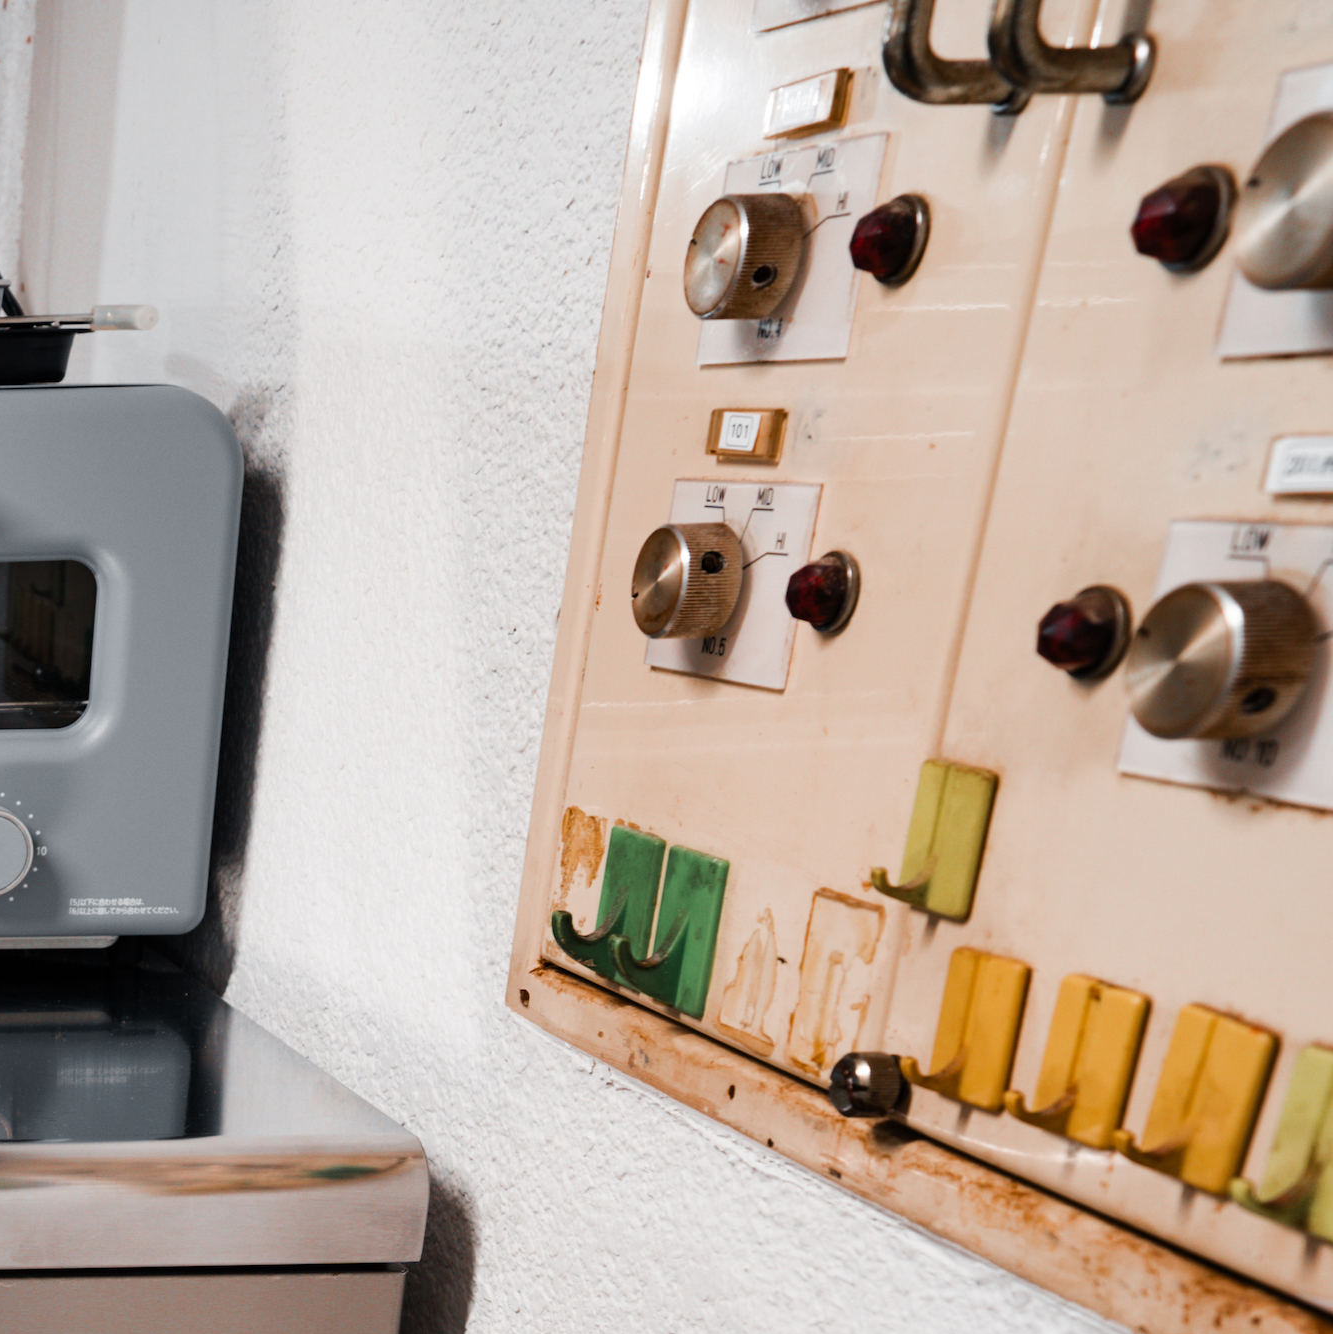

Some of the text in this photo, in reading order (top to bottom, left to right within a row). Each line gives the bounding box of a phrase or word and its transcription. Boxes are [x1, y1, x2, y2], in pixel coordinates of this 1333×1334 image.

[815, 148, 836, 168] MID
[760, 160, 783, 180] LOW
[836, 191, 849, 211] HI
[731, 423, 750, 439] 101
[705, 485, 727, 504] LOW
[756, 487, 774, 506] MID
[775, 532, 787, 550] HI
[1230, 525, 1272, 551] LOW
[701, 636, 726, 657] NO.5
[36, 846, 48, 856] 10
